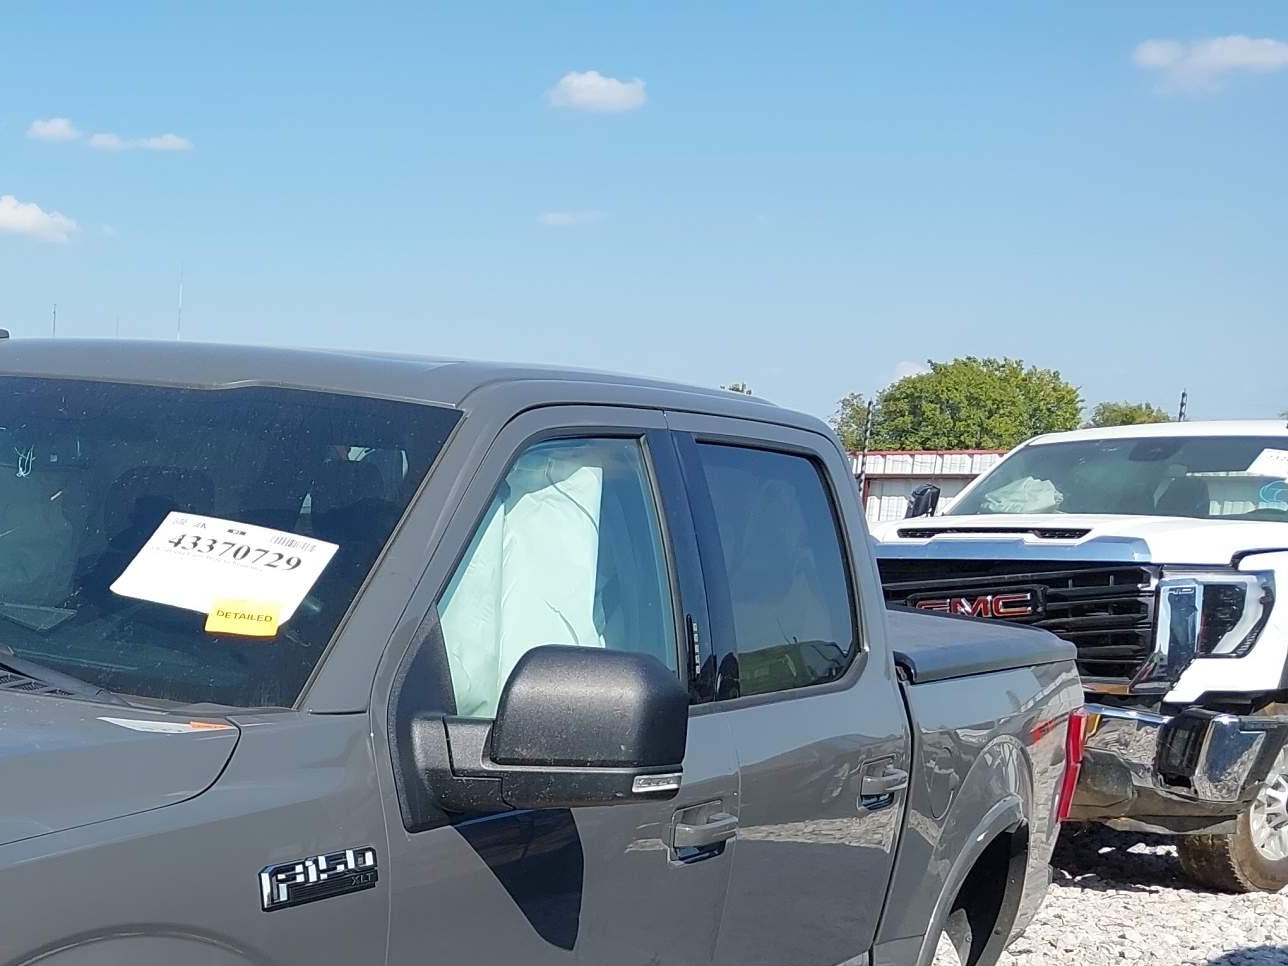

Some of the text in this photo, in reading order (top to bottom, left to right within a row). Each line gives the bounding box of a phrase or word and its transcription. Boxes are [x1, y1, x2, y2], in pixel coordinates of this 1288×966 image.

[168, 533, 302, 571] 43370729
[216, 609, 273, 623] DETAILED
[351, 871, 374, 886] XLT
